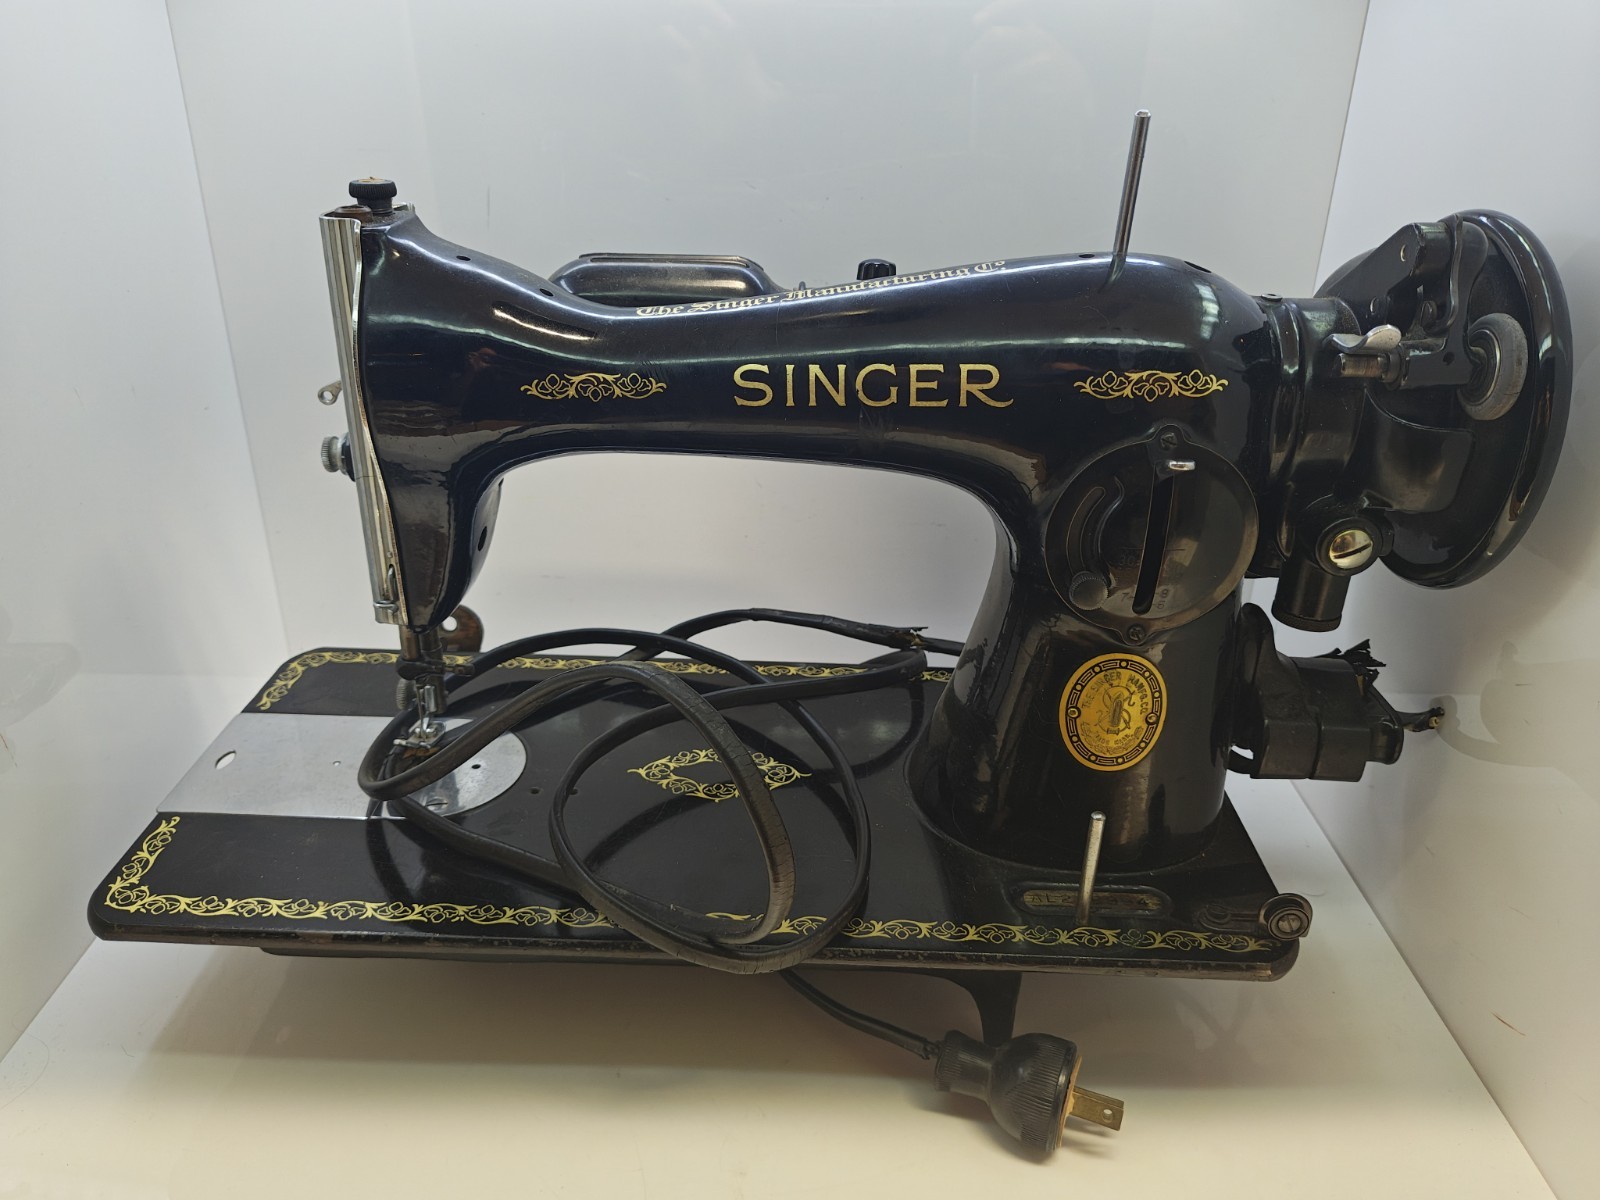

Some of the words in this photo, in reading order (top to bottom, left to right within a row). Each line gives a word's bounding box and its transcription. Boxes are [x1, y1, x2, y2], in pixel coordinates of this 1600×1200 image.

[636, 305, 685, 317] The
[687, 295, 780, 313] Singer
[782, 267, 971, 301] Manufacturing
[733, 363, 1014, 408] SINGER
